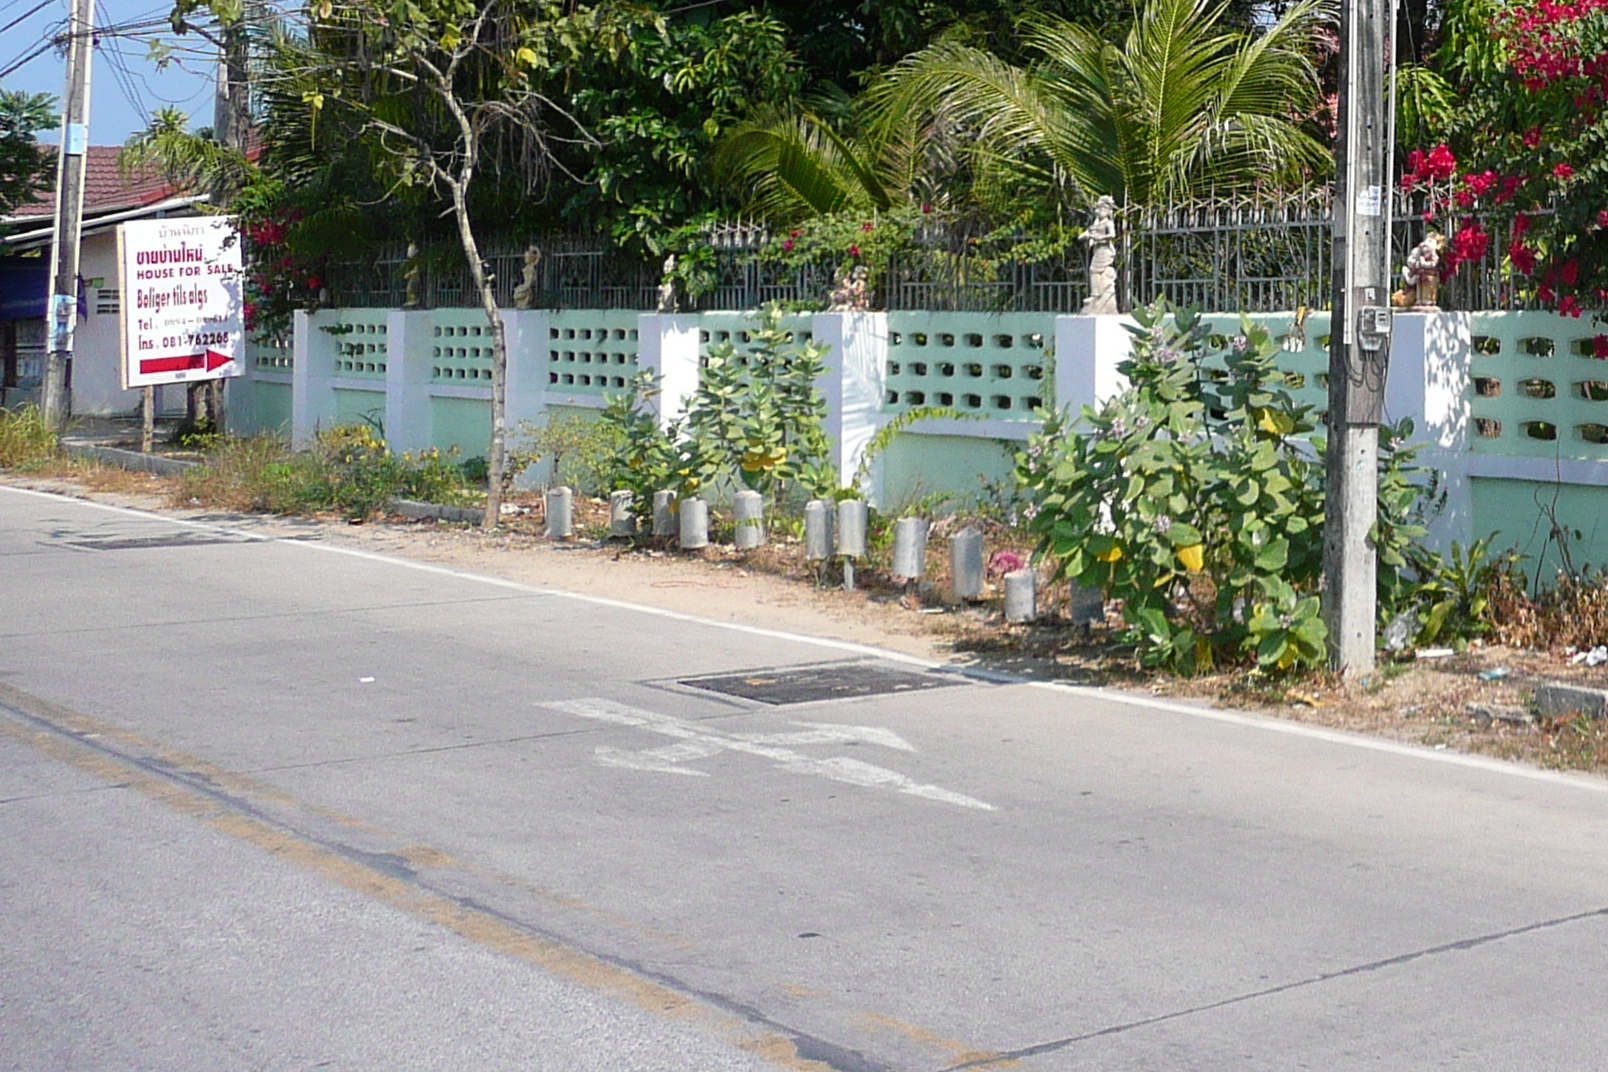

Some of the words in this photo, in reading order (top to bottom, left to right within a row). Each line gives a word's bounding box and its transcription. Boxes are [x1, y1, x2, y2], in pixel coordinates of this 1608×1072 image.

[136, 268, 175, 280] HOUSE
[179, 266, 201, 277] FOR
[207, 263, 233, 275] SALE
[137, 286, 170, 314] Boliger
